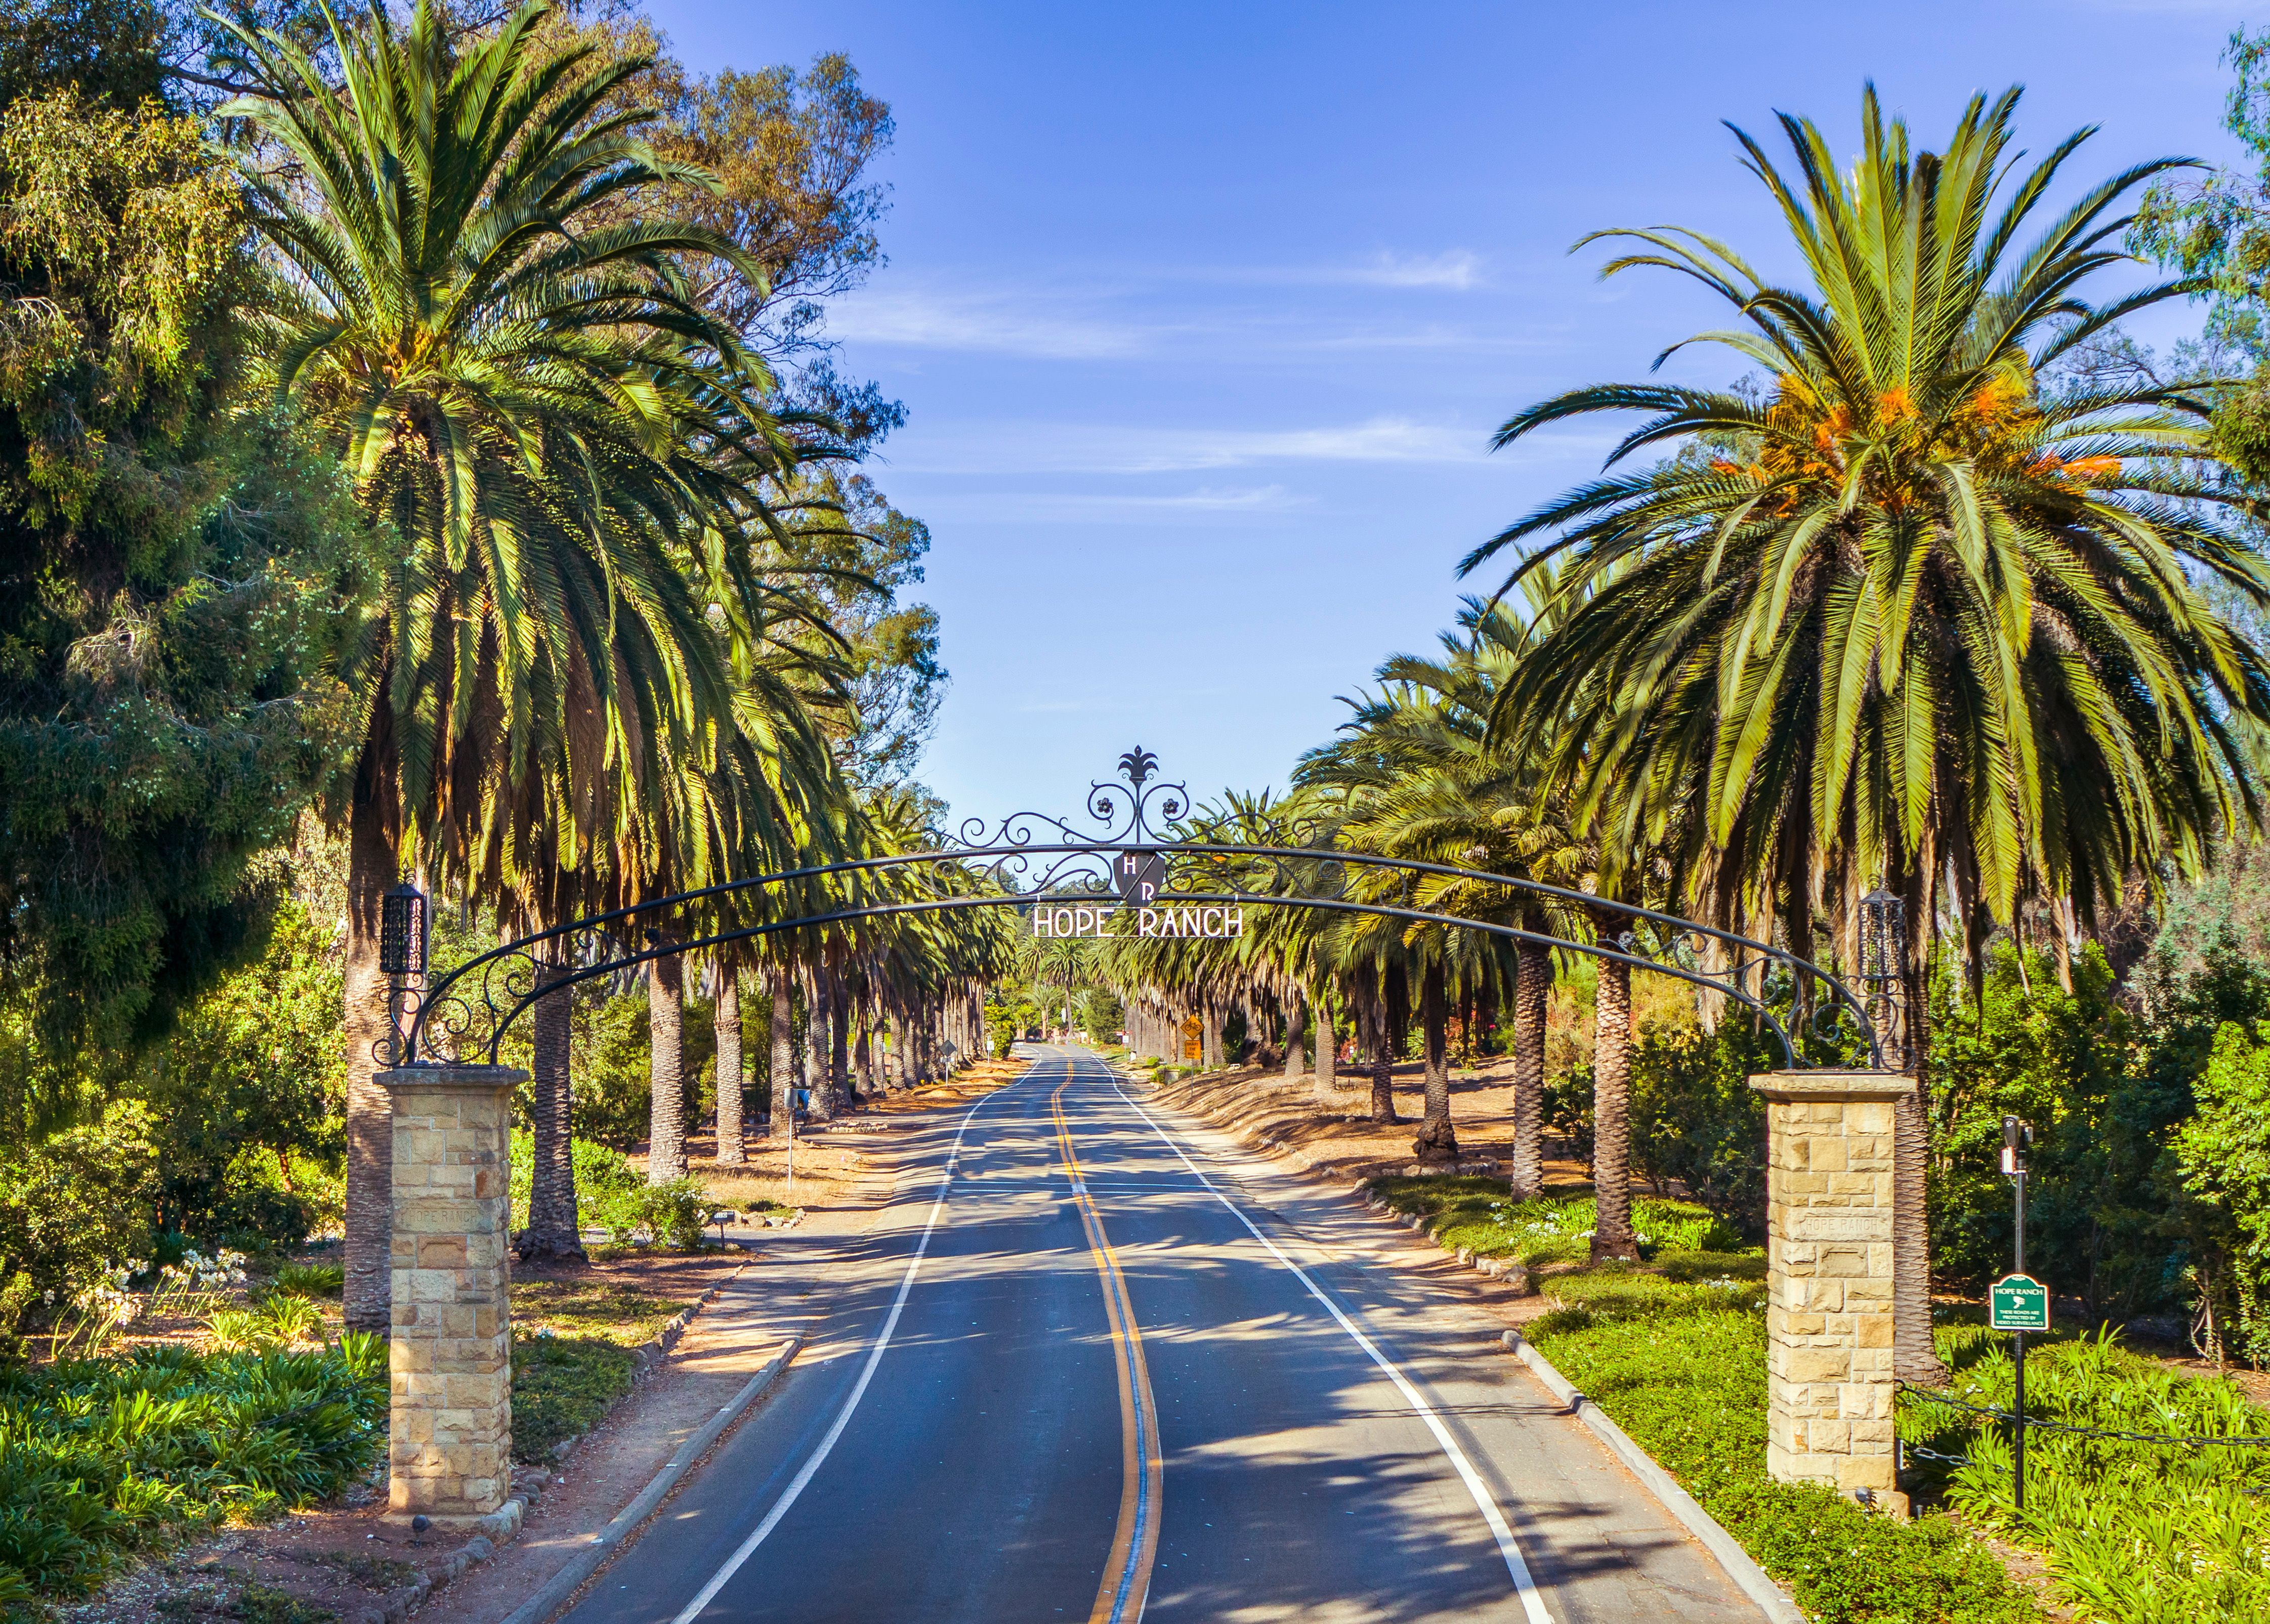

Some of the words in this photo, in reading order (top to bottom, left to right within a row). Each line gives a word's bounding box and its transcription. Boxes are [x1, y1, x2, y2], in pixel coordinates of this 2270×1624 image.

[1123, 856, 1136, 874] H
[1141, 882, 1155, 900] R
[1034, 908, 1114, 937] HOPE
[1140, 908, 1242, 937] RANCH
[409, 1211, 438, 1223] HOPE
[442, 1211, 477, 1223] RANCH
[1805, 1219, 1835, 1231] HOPE
[1840, 1219, 1878, 1231] RANCH
